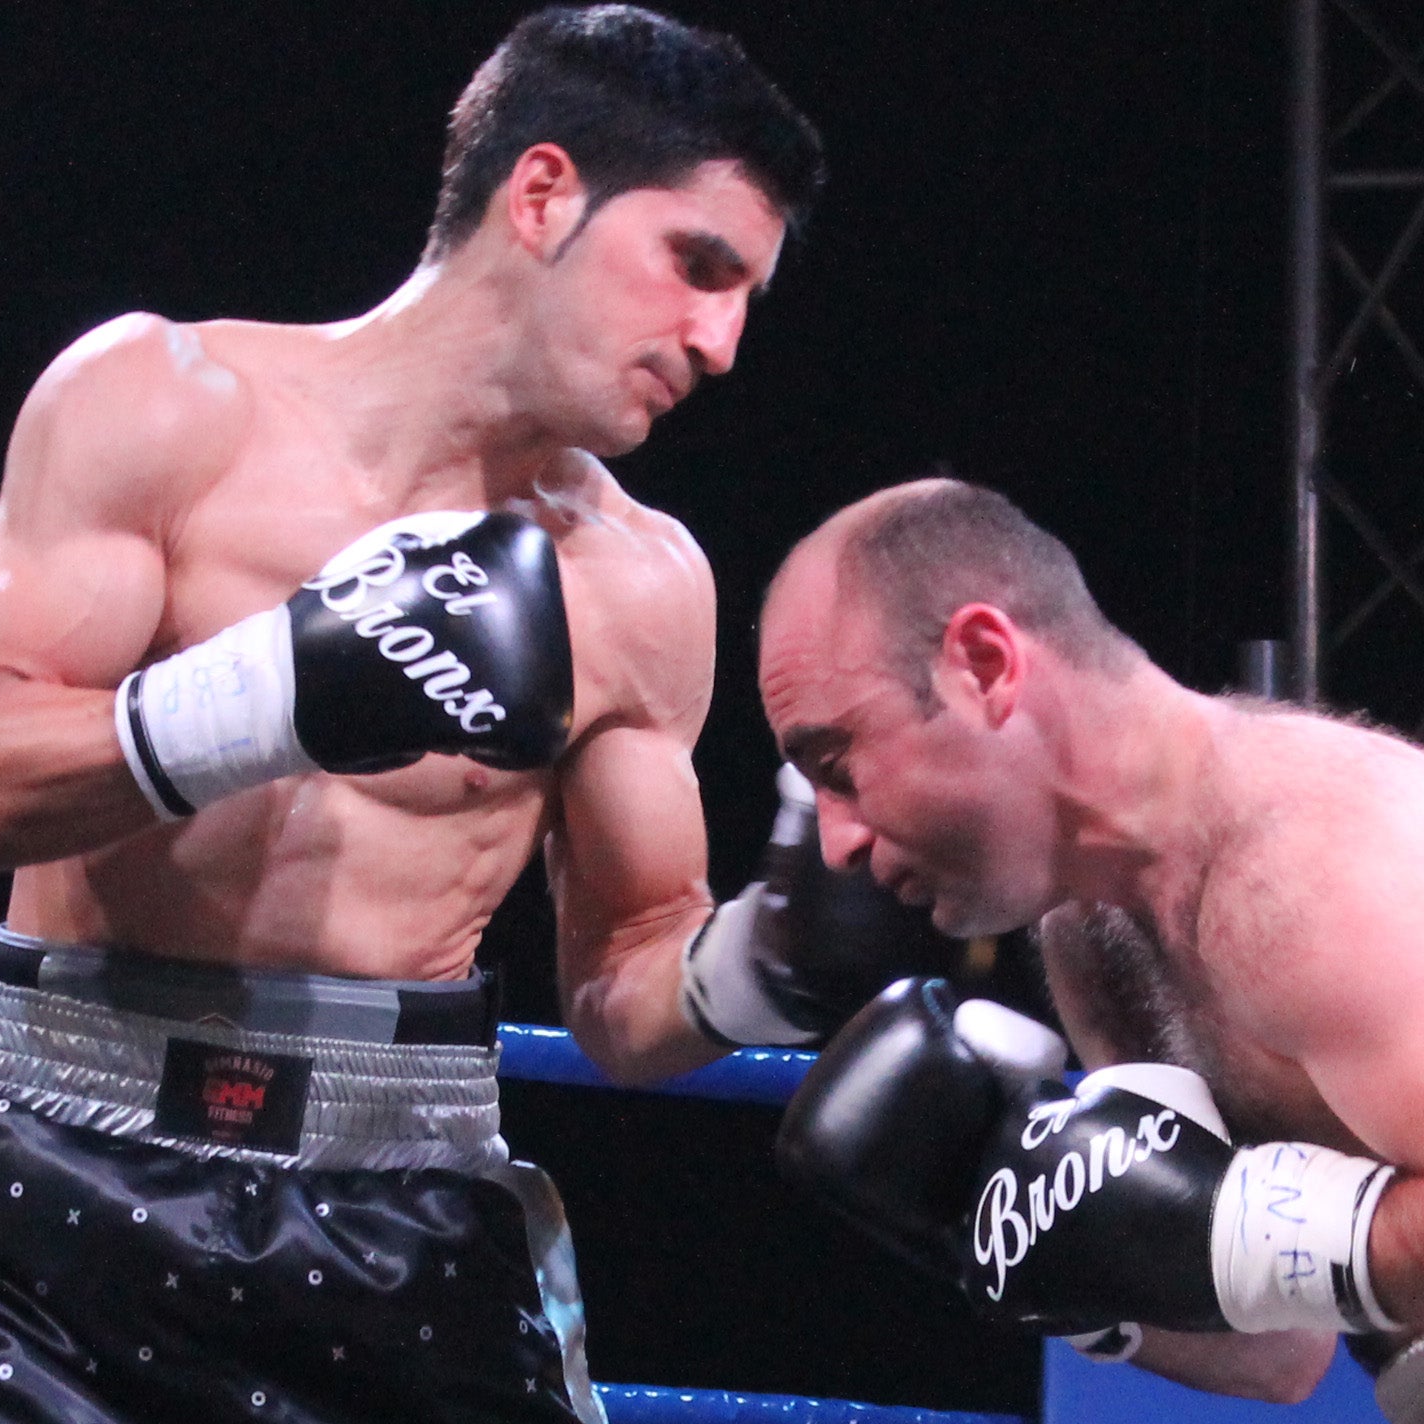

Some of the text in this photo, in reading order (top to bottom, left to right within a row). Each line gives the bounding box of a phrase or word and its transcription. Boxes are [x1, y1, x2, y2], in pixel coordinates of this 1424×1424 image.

[302, 541, 506, 734] Bronx
[422, 551, 498, 617] El
[974, 1108, 1182, 1302] Bronx
